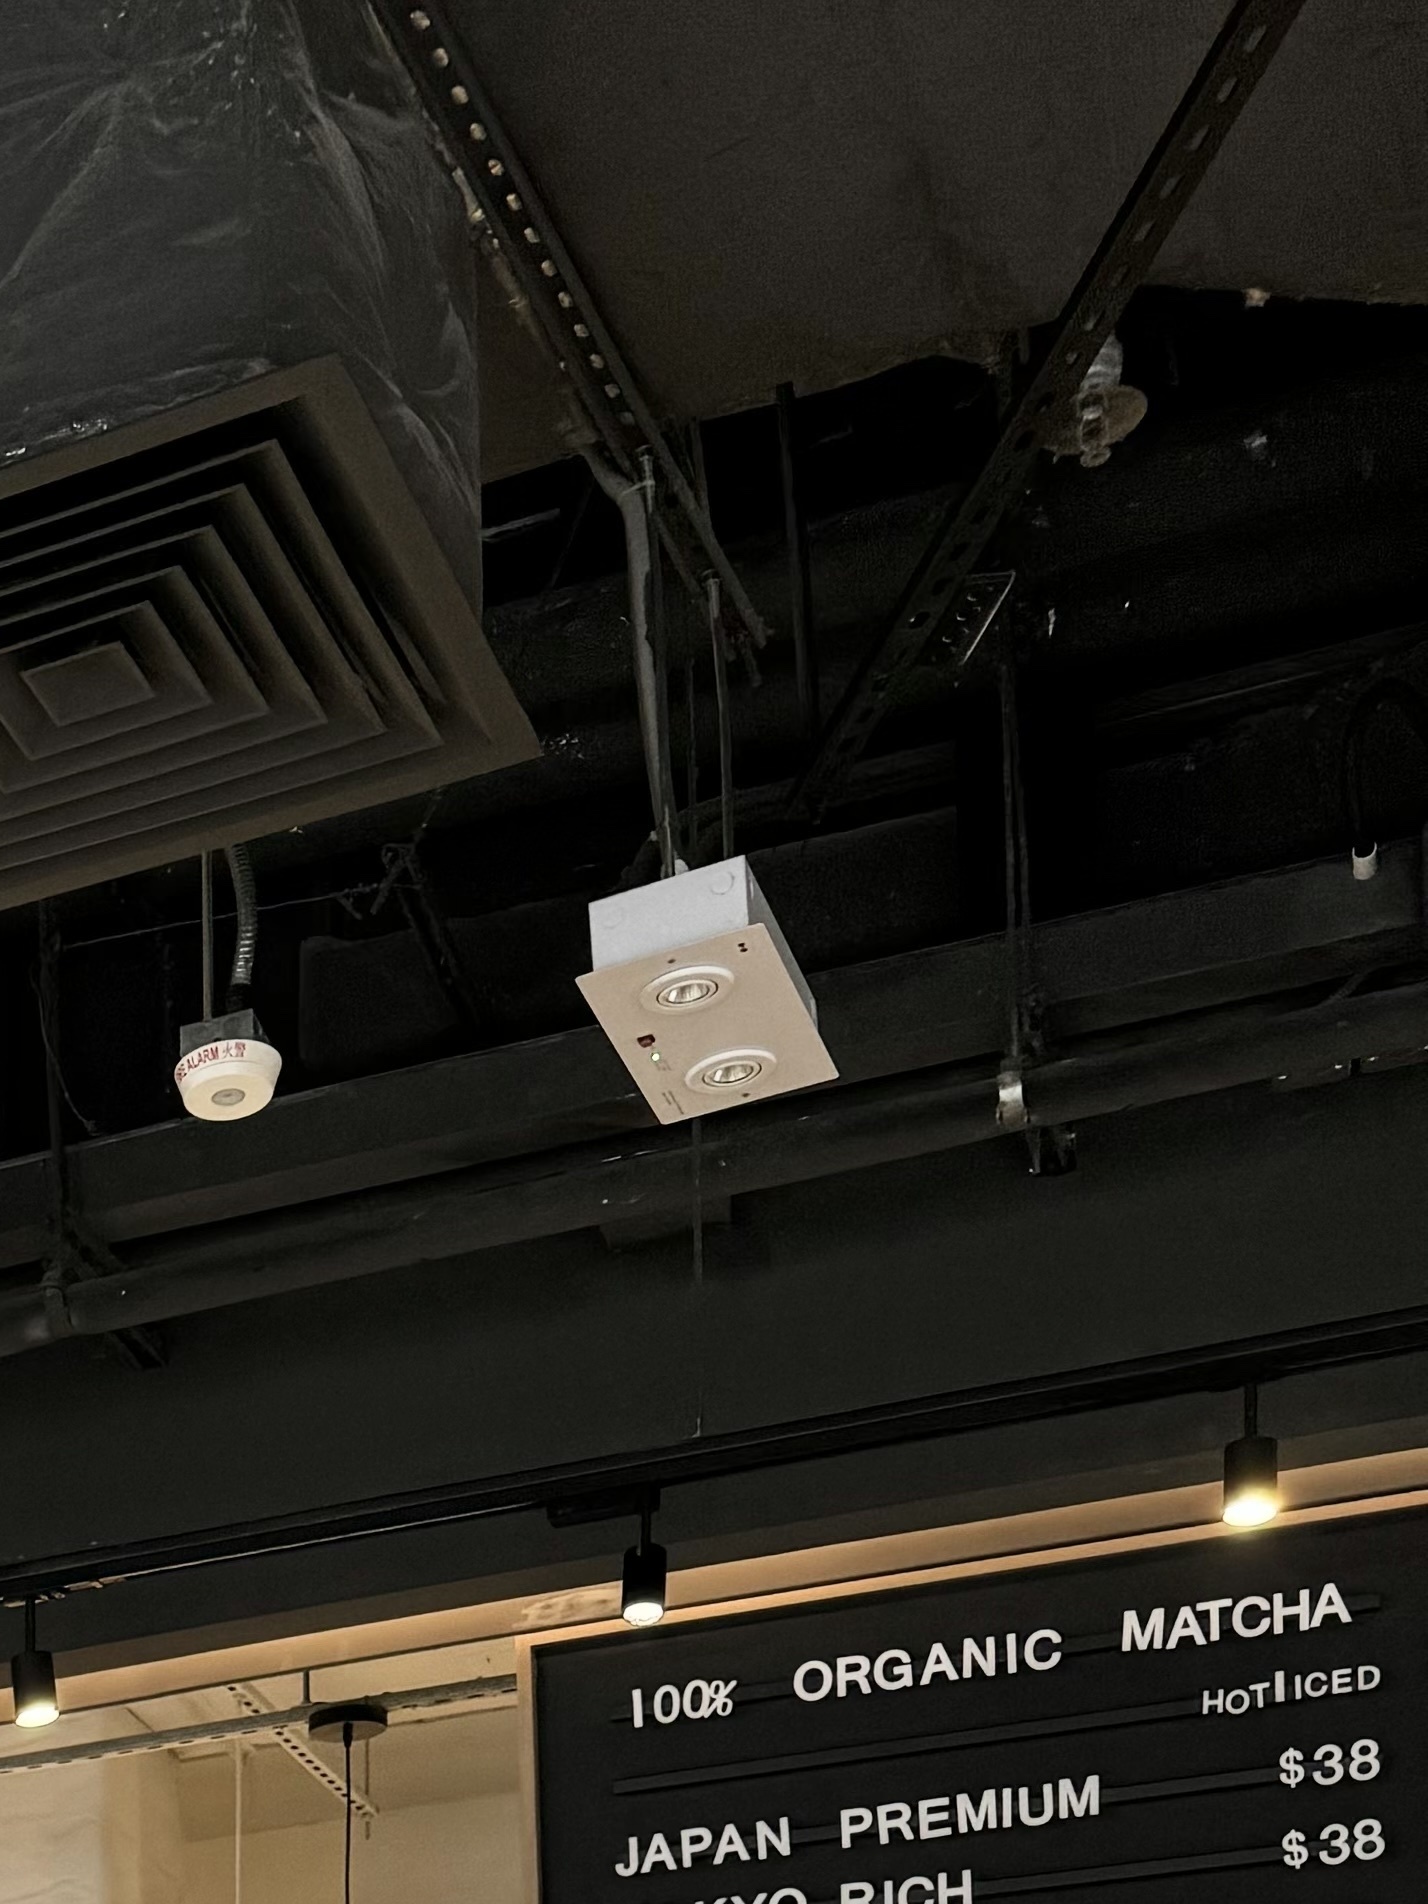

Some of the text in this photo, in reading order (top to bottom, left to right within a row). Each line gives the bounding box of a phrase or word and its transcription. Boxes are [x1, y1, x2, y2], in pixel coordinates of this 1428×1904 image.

[187, 1046, 220, 1071] ALARM
[223, 1042, 246, 1059] 火警
[632, 1583, 1352, 1727] 100% ORGANIC MATCHA
[616, 1739, 1381, 1876] JAPAN PREMIUM $38
[1282, 1819, 1386, 1869] $38
